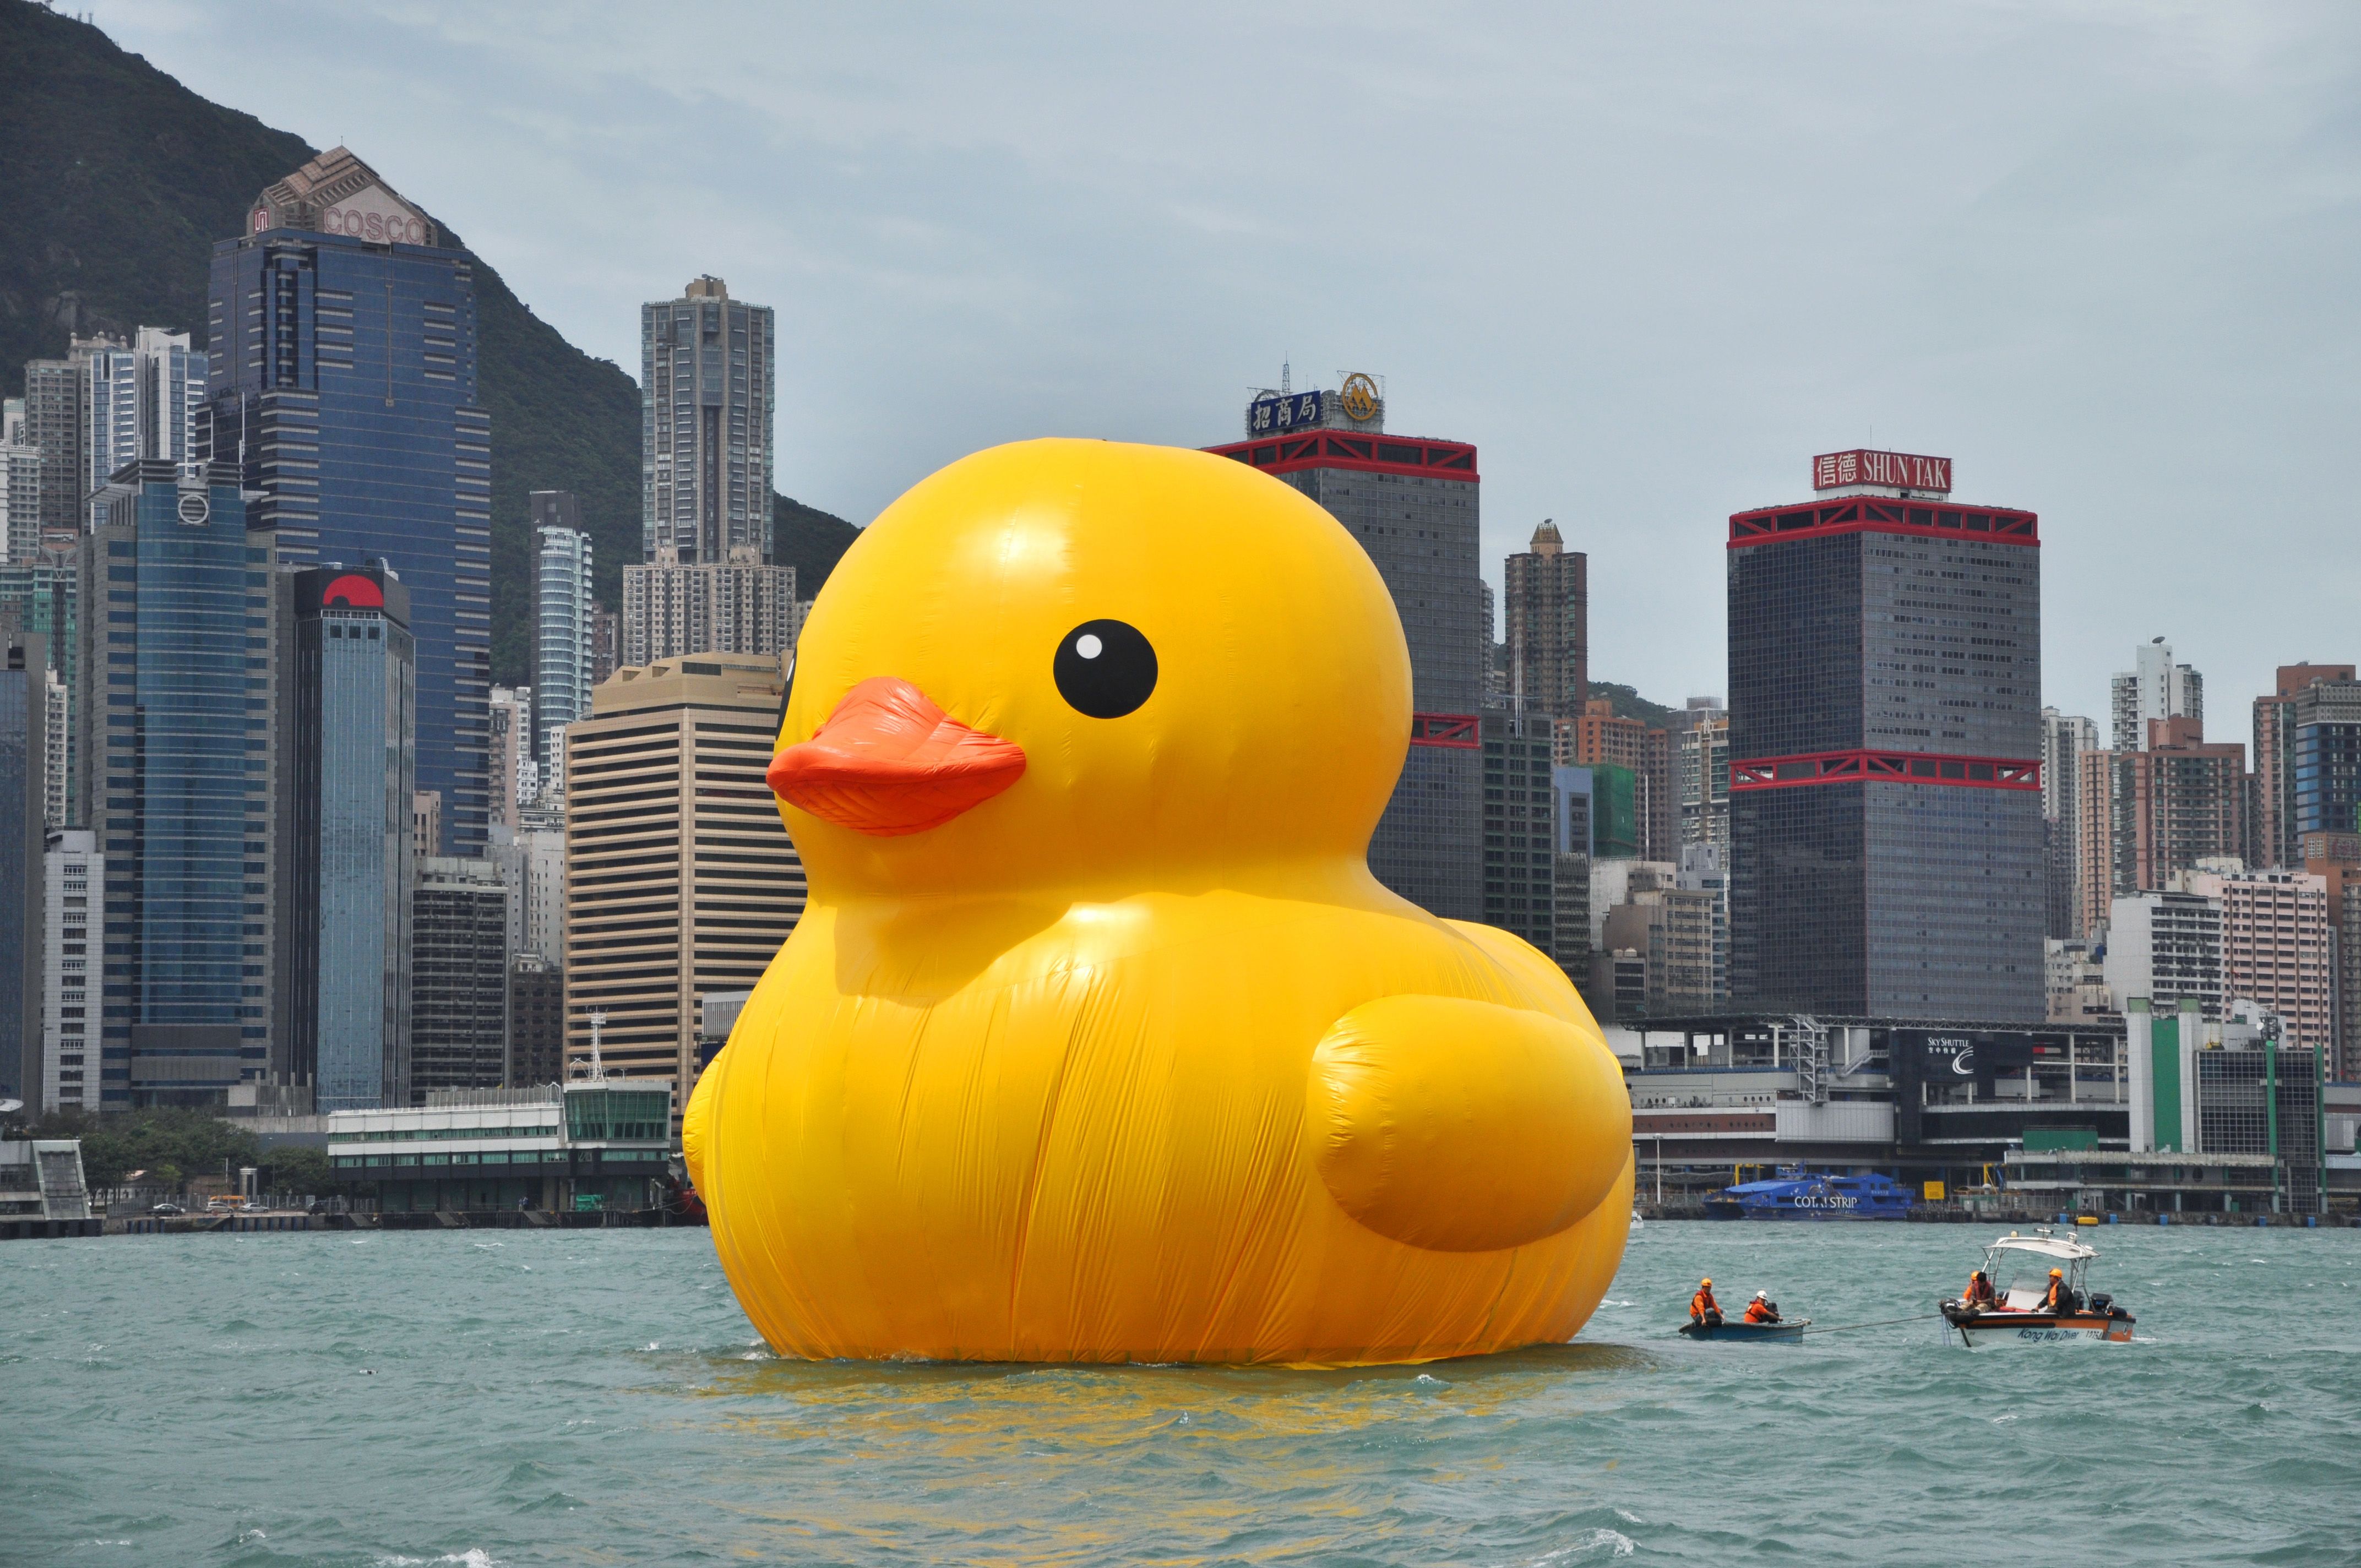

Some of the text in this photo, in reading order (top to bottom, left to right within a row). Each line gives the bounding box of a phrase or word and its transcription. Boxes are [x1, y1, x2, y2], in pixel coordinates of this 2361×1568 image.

[324, 207, 425, 245] COSCO
[1253, 394, 1316, 431] 招商局
[1817, 453, 1857, 486] 信德
[1863, 452, 1947, 488] SHUN TAK
[1928, 1037, 1969, 1047] SKY SHUTTLE
[1830, 1196, 1858, 1208] STRIP
[2017, 1328, 2043, 1342] Kong
